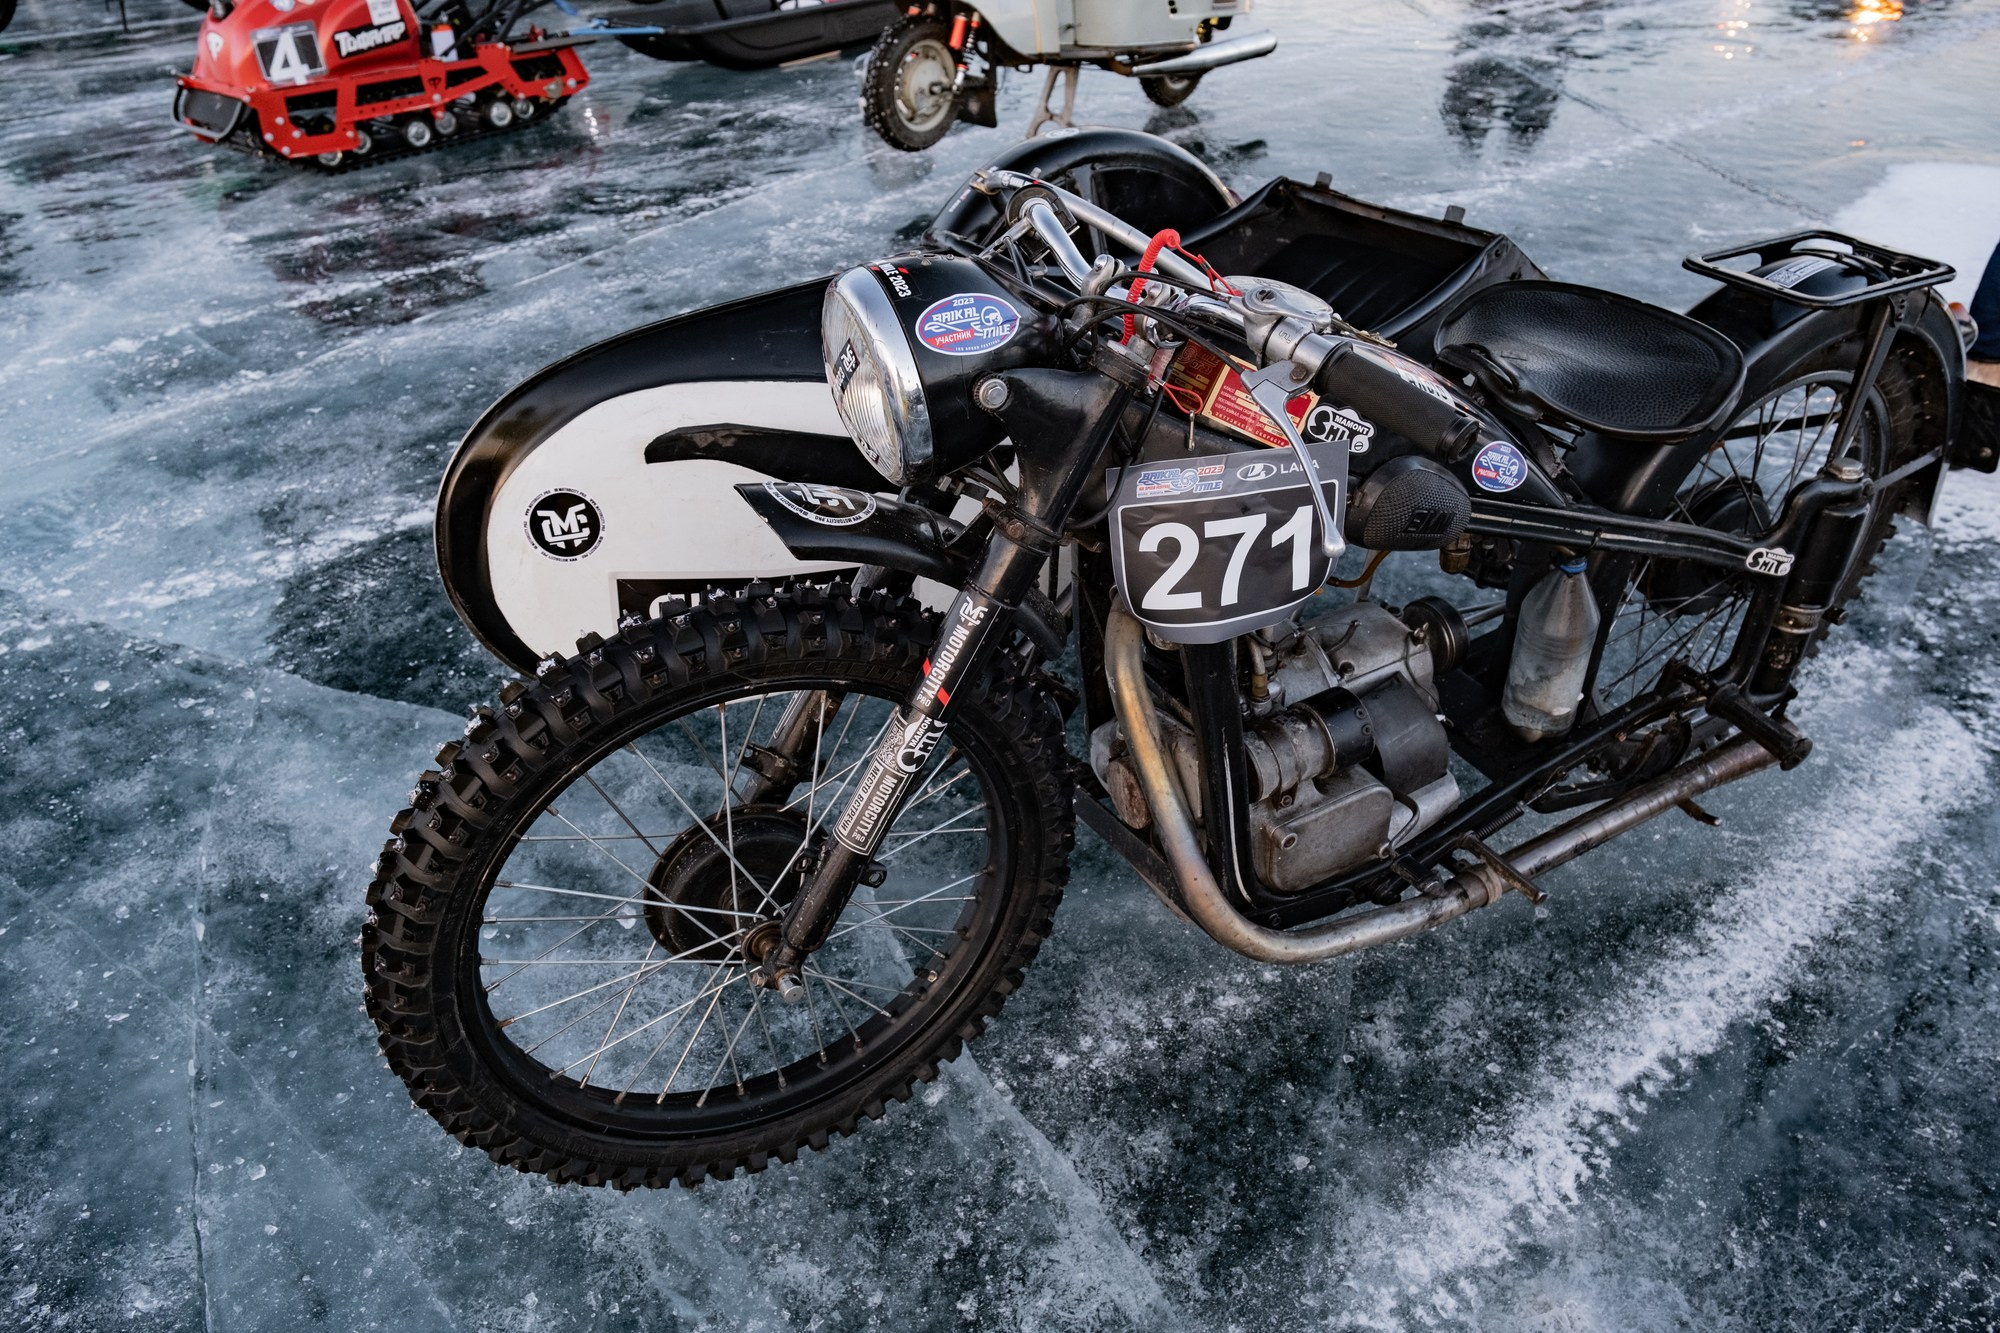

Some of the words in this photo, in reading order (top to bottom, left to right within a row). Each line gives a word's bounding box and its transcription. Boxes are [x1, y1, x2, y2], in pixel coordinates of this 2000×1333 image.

[269, 31, 310, 85] 4
[889, 275, 912, 297] 2023
[952, 297, 974, 307] 2023
[932, 307, 980, 323] BAIKAL
[935, 330, 972, 346] УЧАСТНИК
[982, 324, 1011, 339] MILE
[1334, 415, 1369, 435] MAMONT
[1142, 469, 1181, 480] BAIKAL
[1198, 466, 1224, 475] 2023
[1280, 459, 1320, 474] LAA
[1193, 481, 1222, 492] MILE
[1138, 505, 1314, 610] 271
[909, 716, 933, 748] MAMON
[861, 766, 880, 794] МЕСТО
[840, 795, 864, 832] ВСТРЕЧИ
